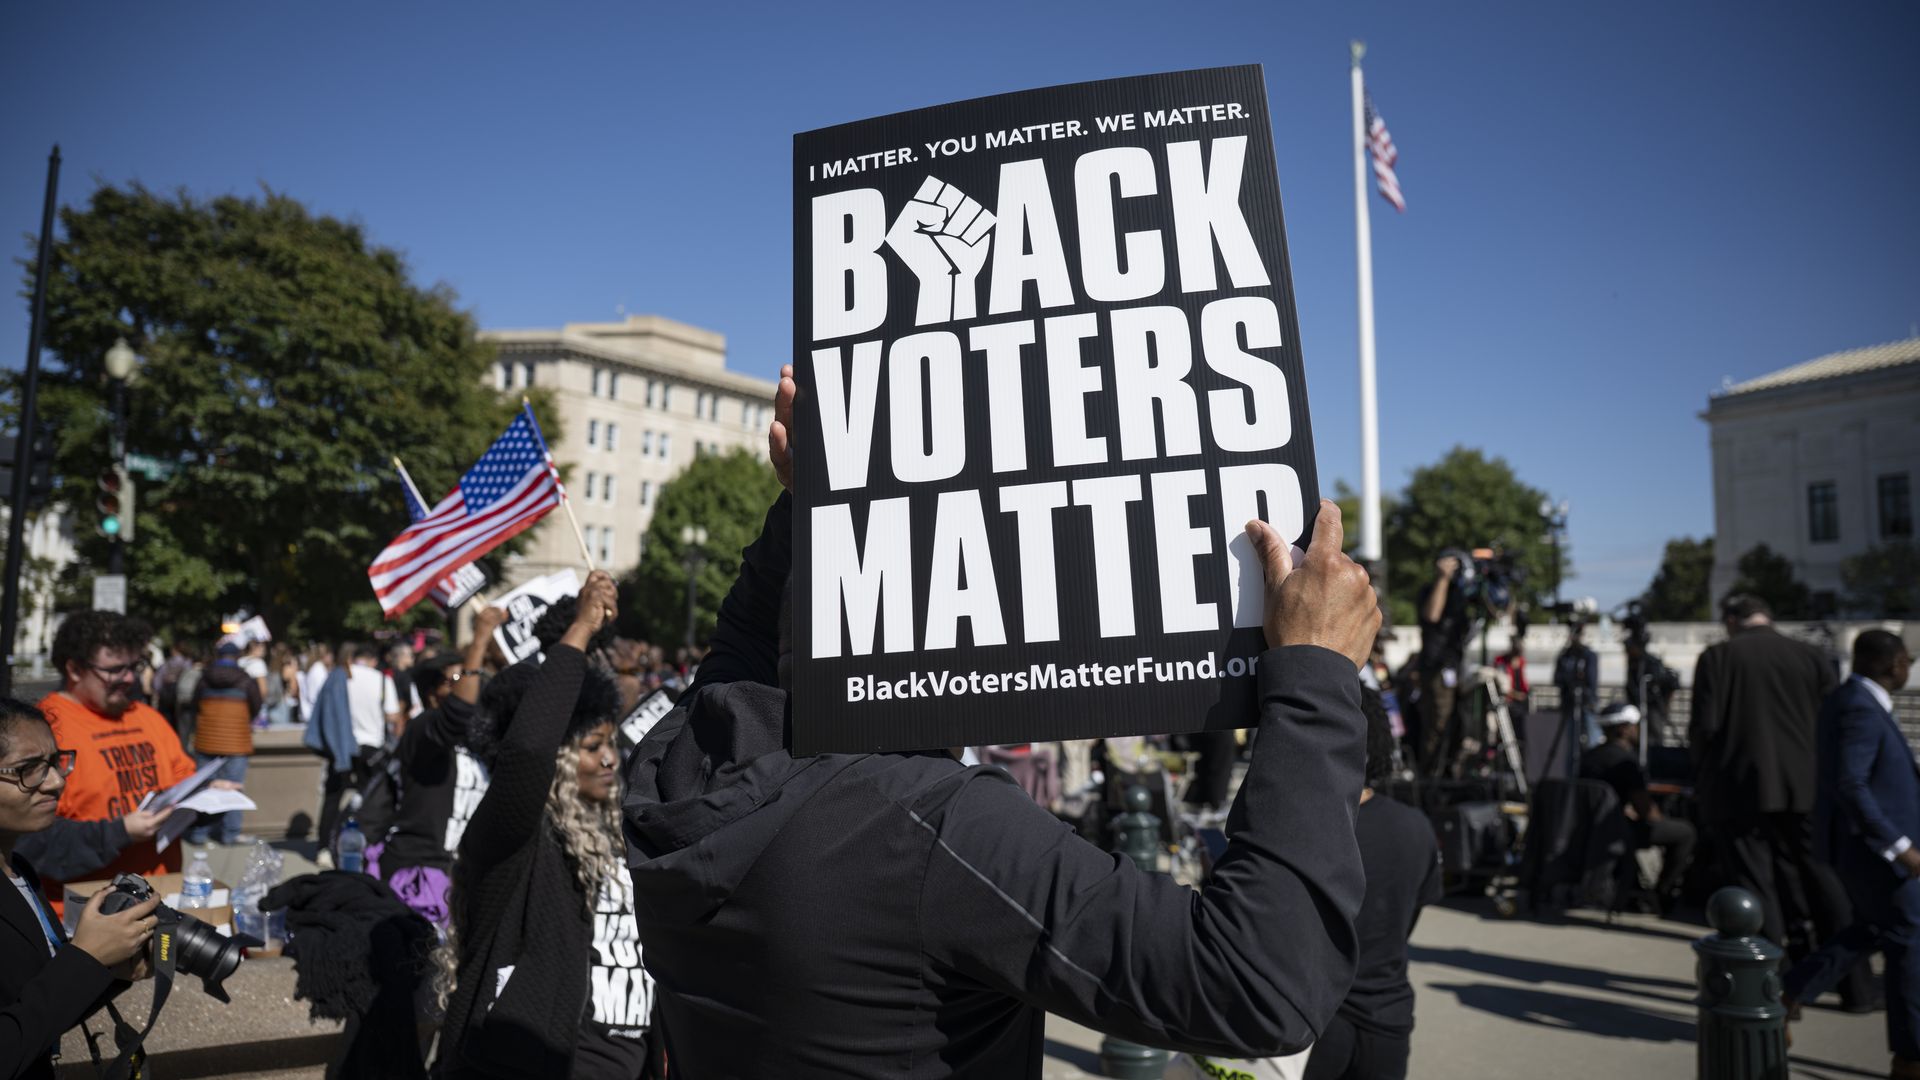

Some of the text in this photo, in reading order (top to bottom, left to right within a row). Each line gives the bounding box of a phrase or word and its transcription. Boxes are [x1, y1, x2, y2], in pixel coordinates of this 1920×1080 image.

[809, 102, 1250, 182] I MATTER. YOU MATTER. WE MATTER.
[811, 296, 1293, 491] VOTERS
[99, 741, 156, 769] TRUMP
[116, 765, 160, 793] MUST
[160, 933, 170, 961] Nikon
